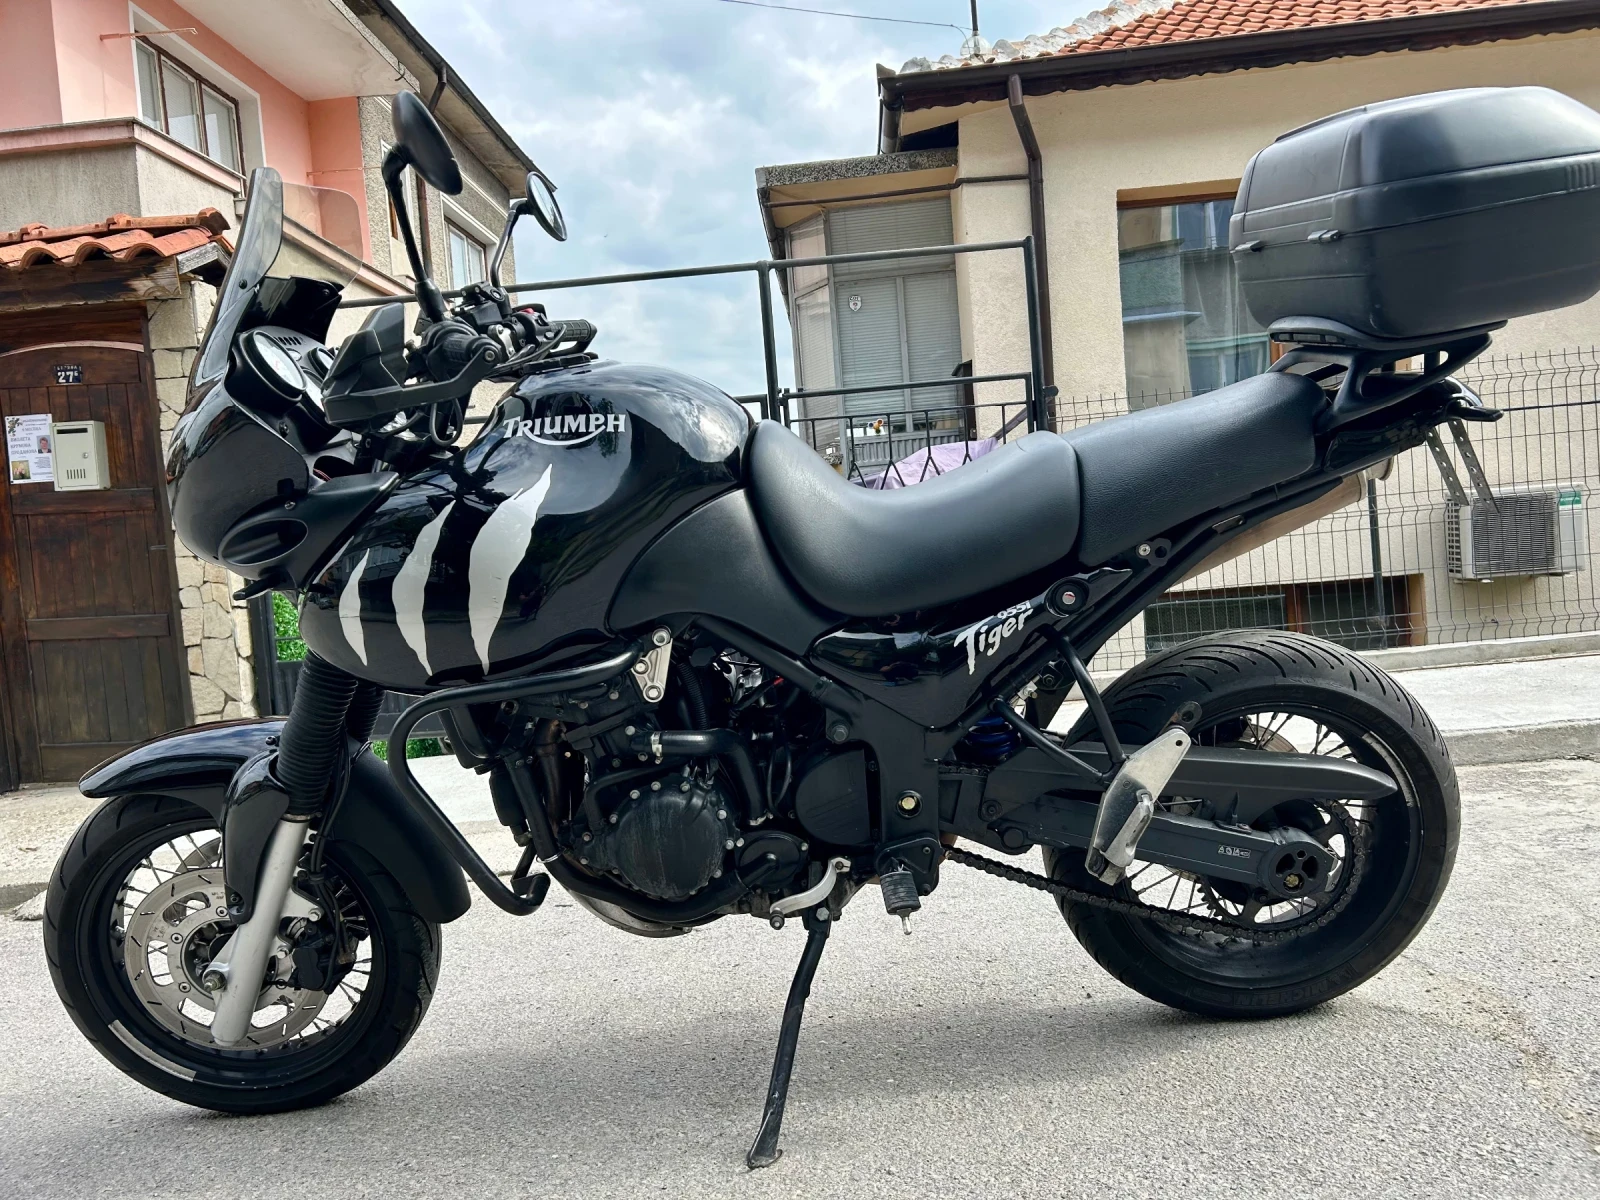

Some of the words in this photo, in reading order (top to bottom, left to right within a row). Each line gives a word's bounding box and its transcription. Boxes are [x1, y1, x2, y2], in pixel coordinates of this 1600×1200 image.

[503, 413, 626, 441] TRIUMPH
[954, 608, 1034, 675] Tiger
[1234, 978, 1329, 1006] MICHELIN
